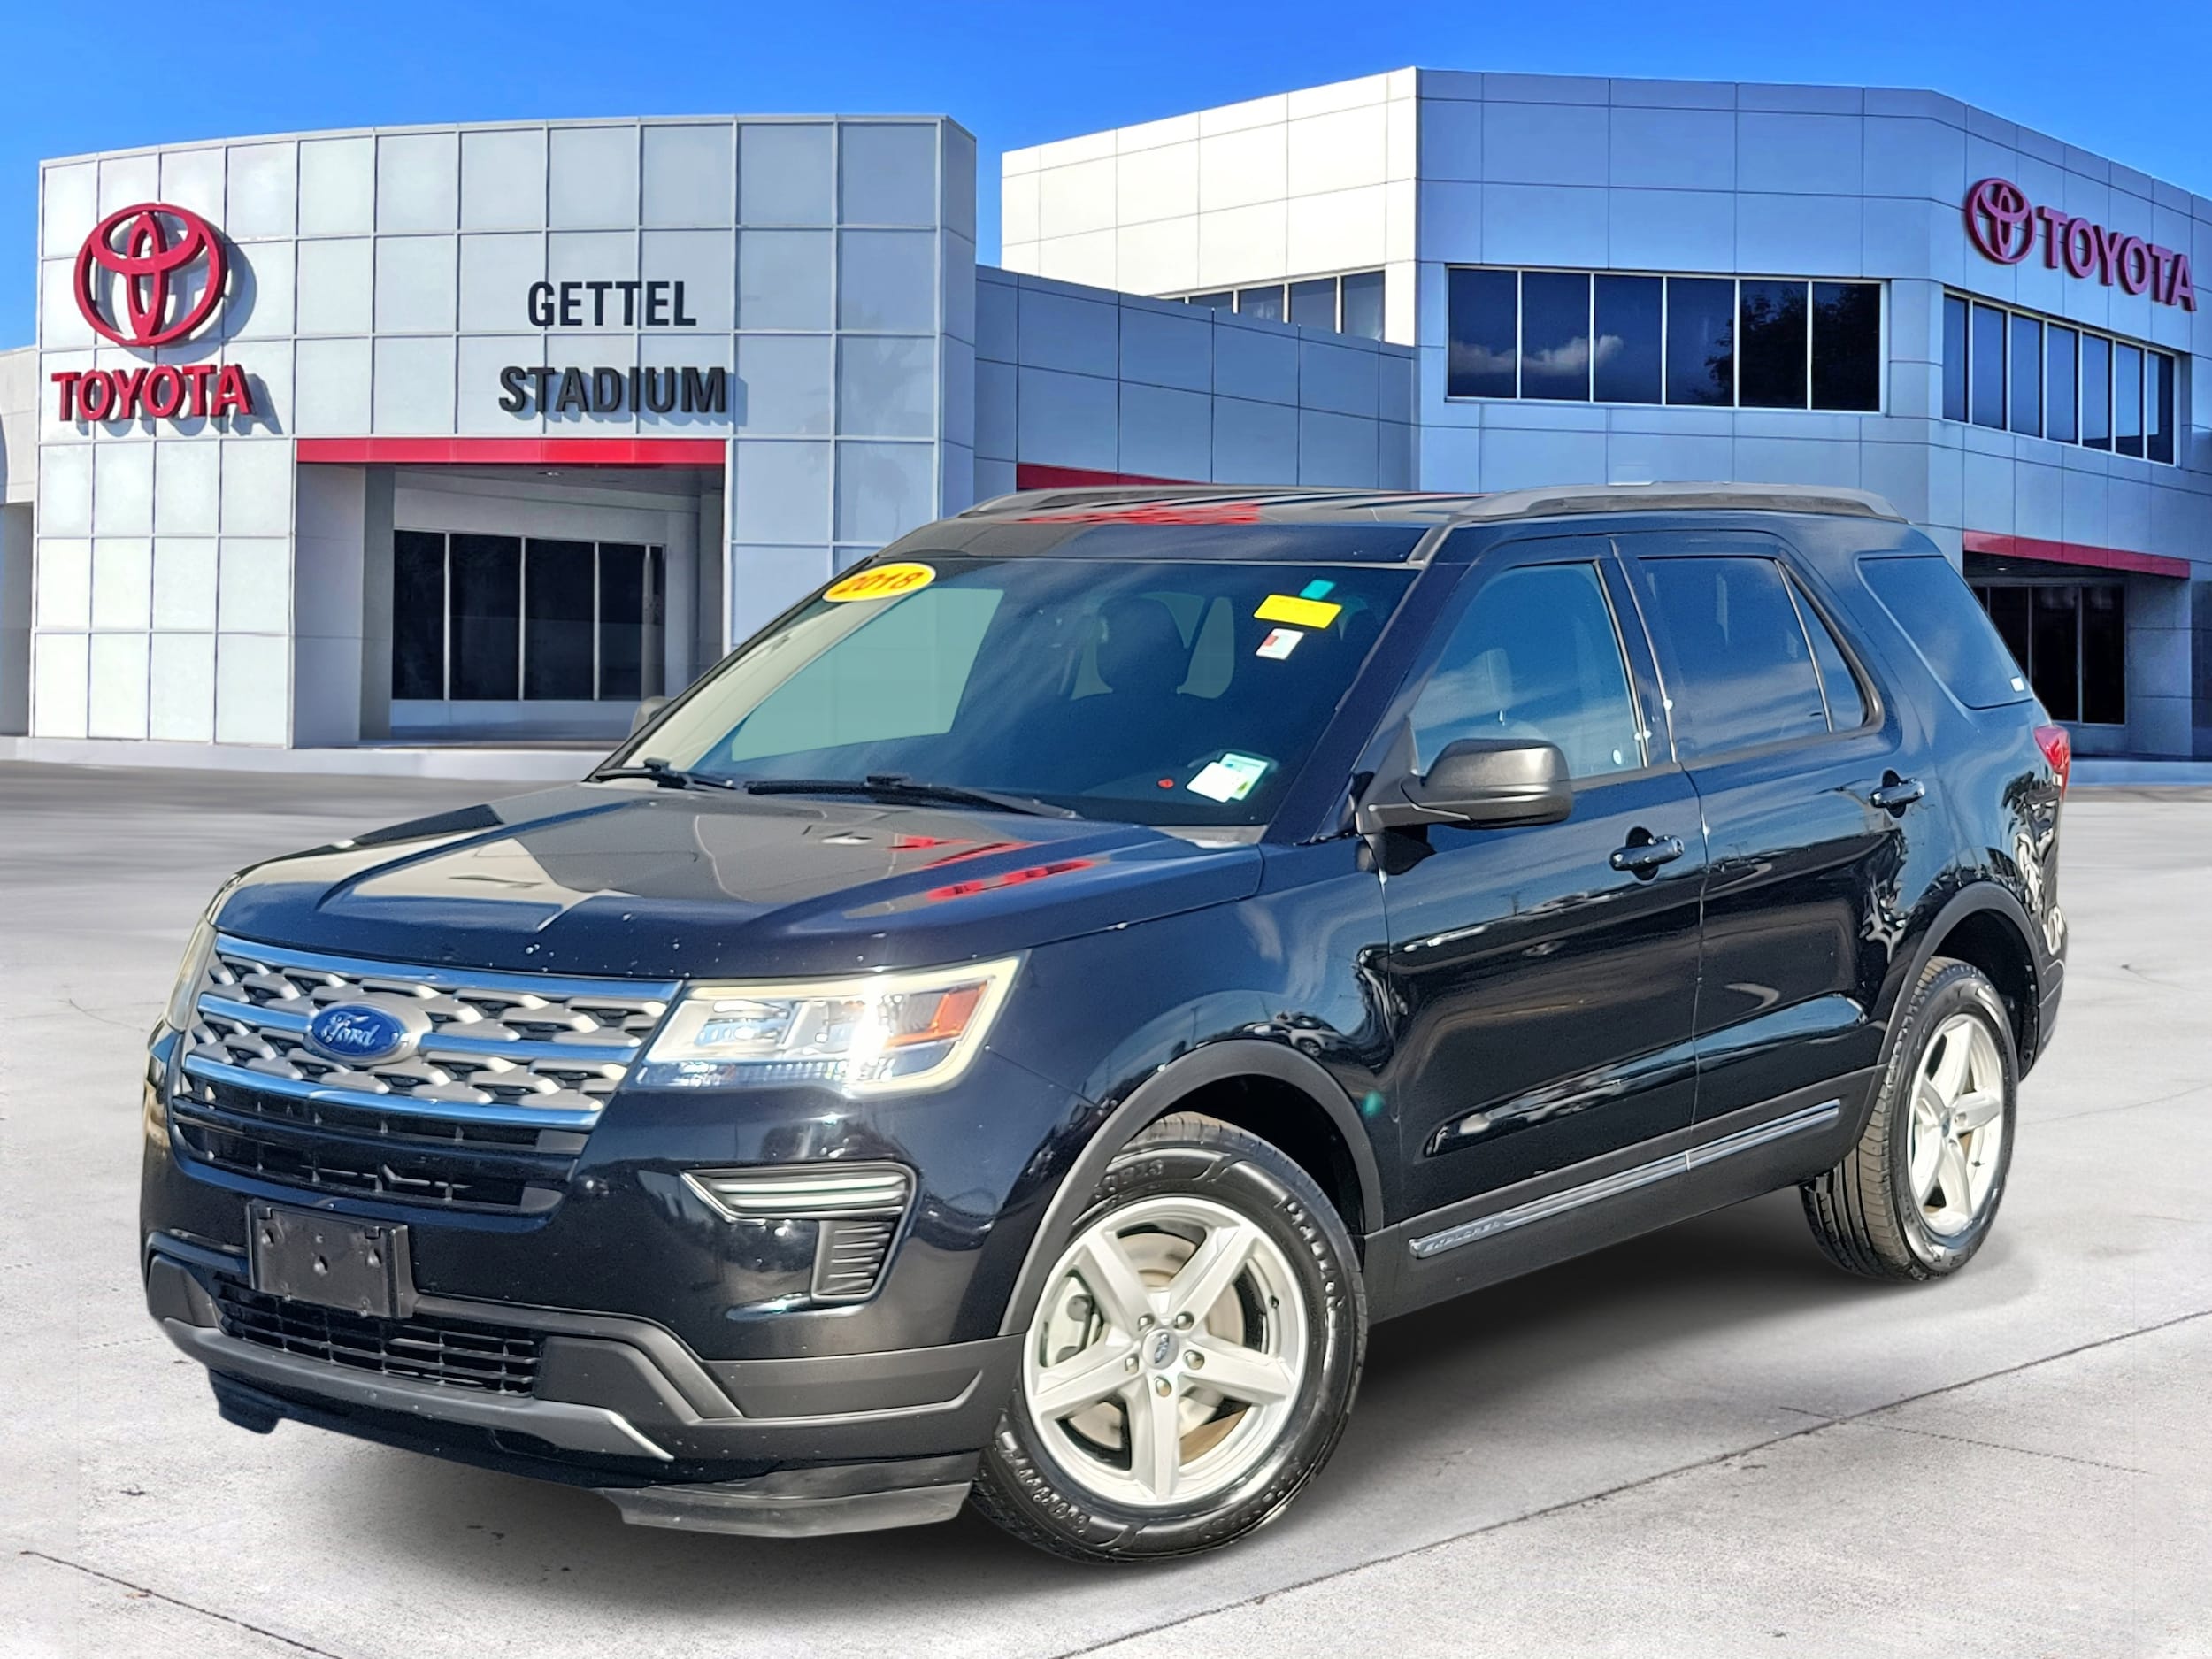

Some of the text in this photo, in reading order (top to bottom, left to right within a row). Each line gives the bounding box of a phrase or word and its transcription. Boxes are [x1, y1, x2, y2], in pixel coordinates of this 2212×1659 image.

[2038, 206, 2197, 311] TOYOTA
[528, 280, 696, 326] GETTEL
[51, 364, 254, 422] TOYOTA
[498, 365, 726, 413] STADIUM
[831, 572, 925, 595] 2018
[320, 1011, 381, 1048] Ford
